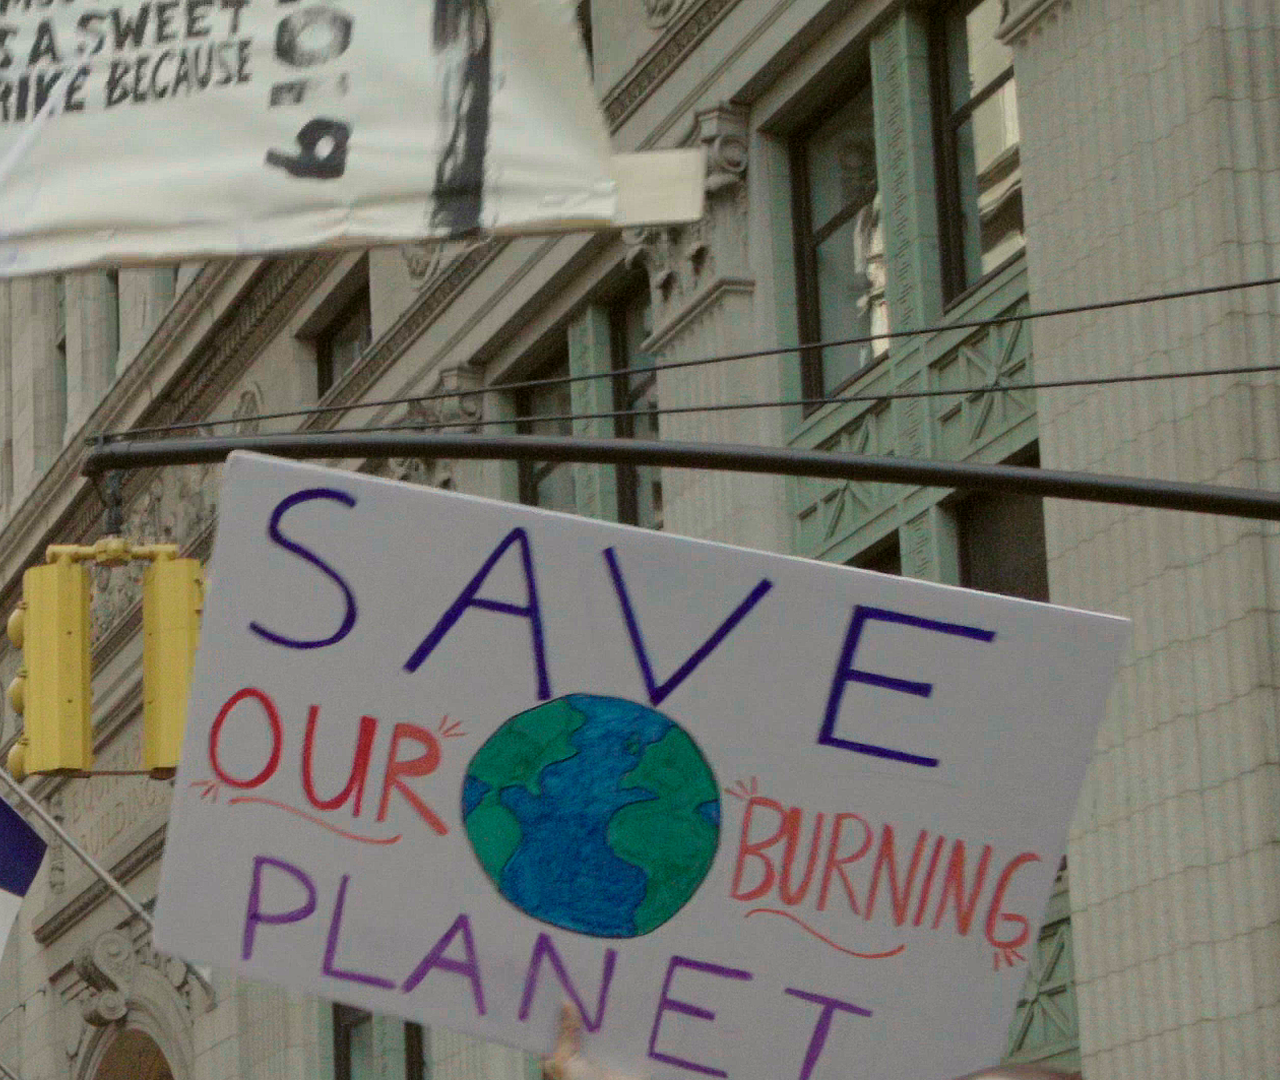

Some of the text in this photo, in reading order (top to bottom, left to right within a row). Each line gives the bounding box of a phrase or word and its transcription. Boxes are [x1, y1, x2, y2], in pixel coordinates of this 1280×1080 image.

[28, 17, 61, 68] A
[76, 0, 244, 54] SWEET
[105, 36, 253, 108] BECAUSE
[247, 486, 997, 769] SAVE
[207, 686, 1041, 951] OUR BURNING
